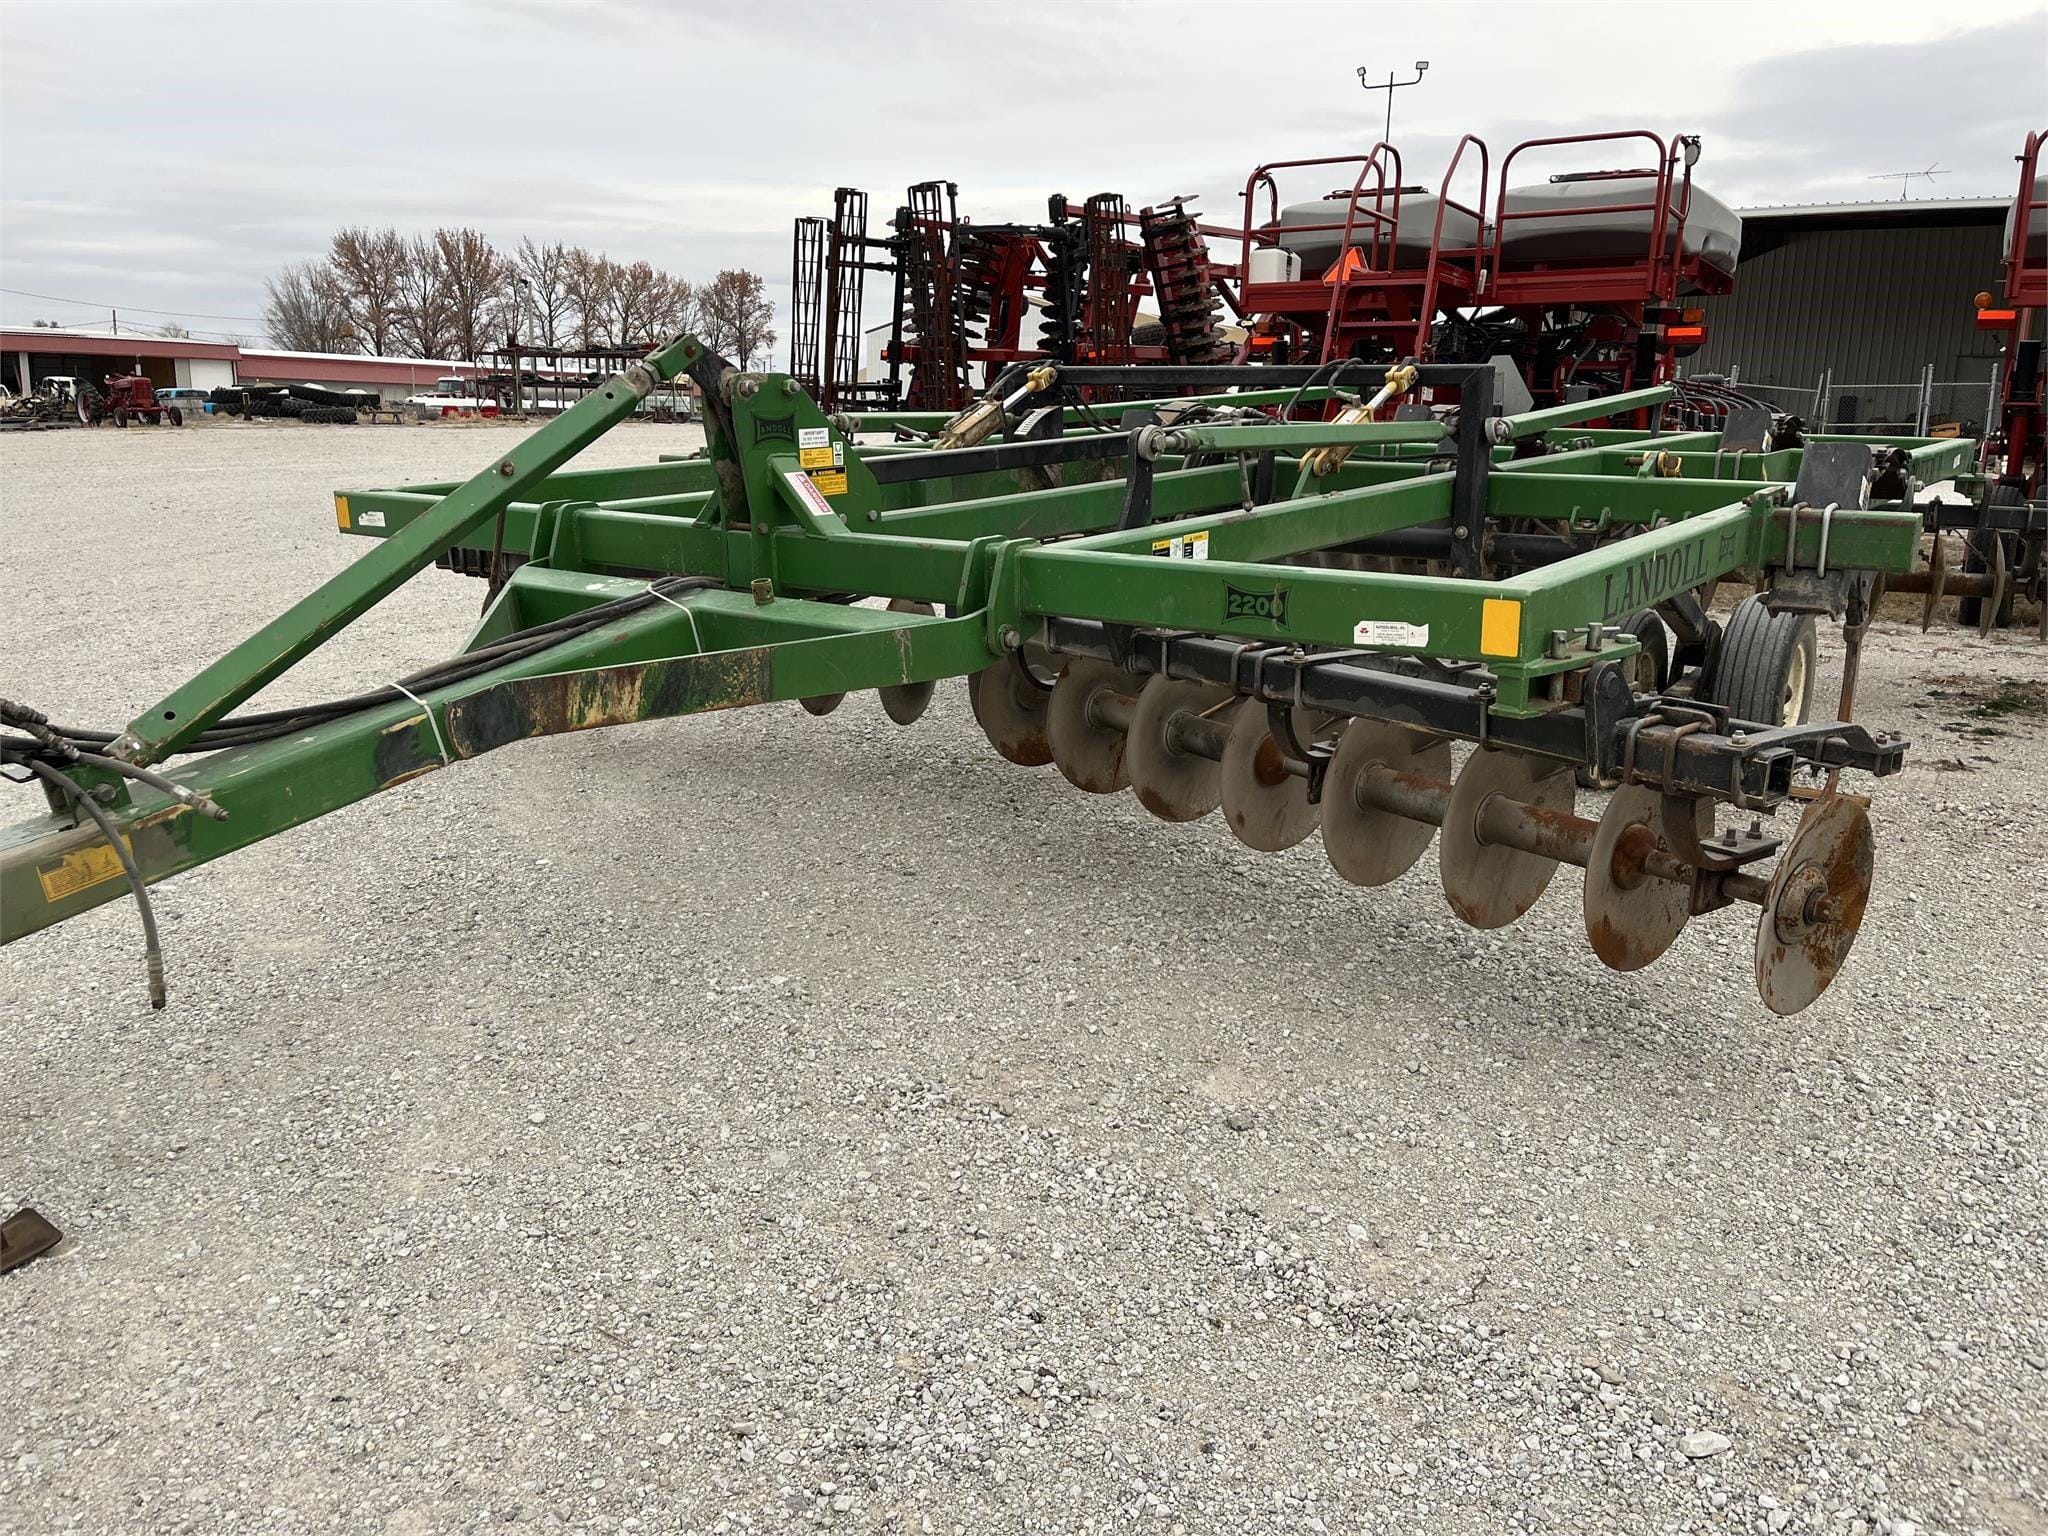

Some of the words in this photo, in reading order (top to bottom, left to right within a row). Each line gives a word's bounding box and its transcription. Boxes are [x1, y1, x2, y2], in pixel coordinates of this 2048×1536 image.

[803, 481, 829, 512] DANGER
[1603, 539, 1709, 620] LANDOLL
[1229, 594, 1284, 617] 2200
